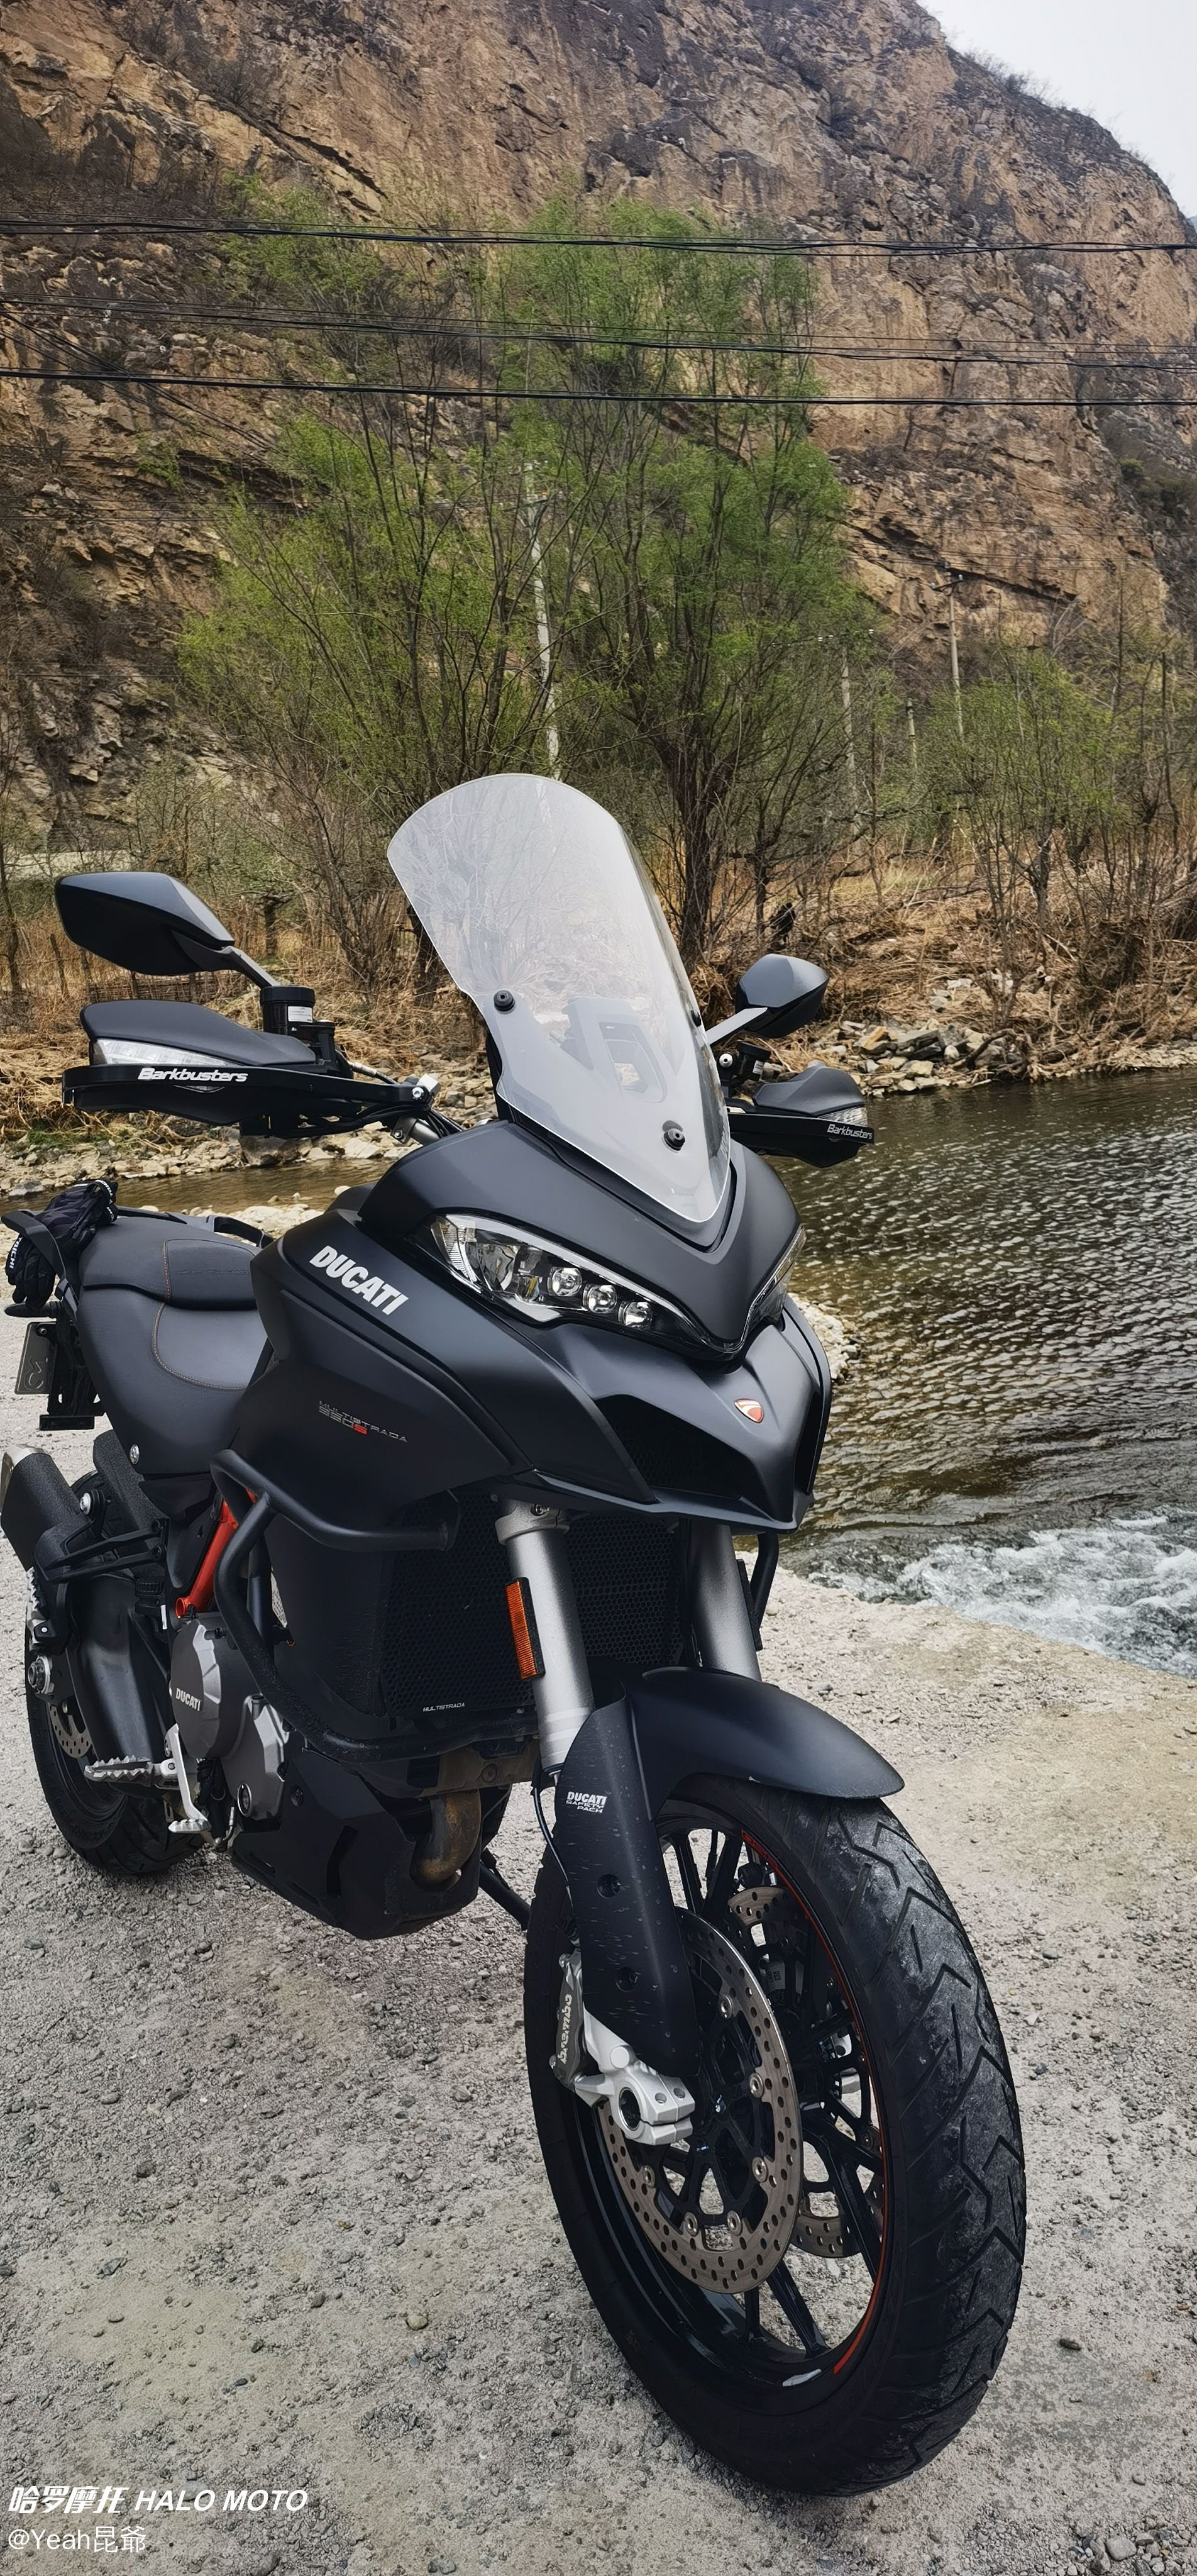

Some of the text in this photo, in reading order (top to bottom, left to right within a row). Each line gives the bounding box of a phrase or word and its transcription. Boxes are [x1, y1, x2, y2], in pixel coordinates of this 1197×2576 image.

[138, 1067, 248, 1082] Barkbusters
[827, 1123, 873, 1140] Barkbusters
[9, 1236, 23, 1269] TAICHI
[309, 1245, 409, 1316] DUCATI
[175, 1687, 201, 1711] DUCATI
[422, 1702, 465, 1712] MULTISTRADA
[565, 1800, 604, 1809] SAFETY
[566, 1791, 607, 1806] DUCATI
[557, 1994, 573, 2064] brembo
